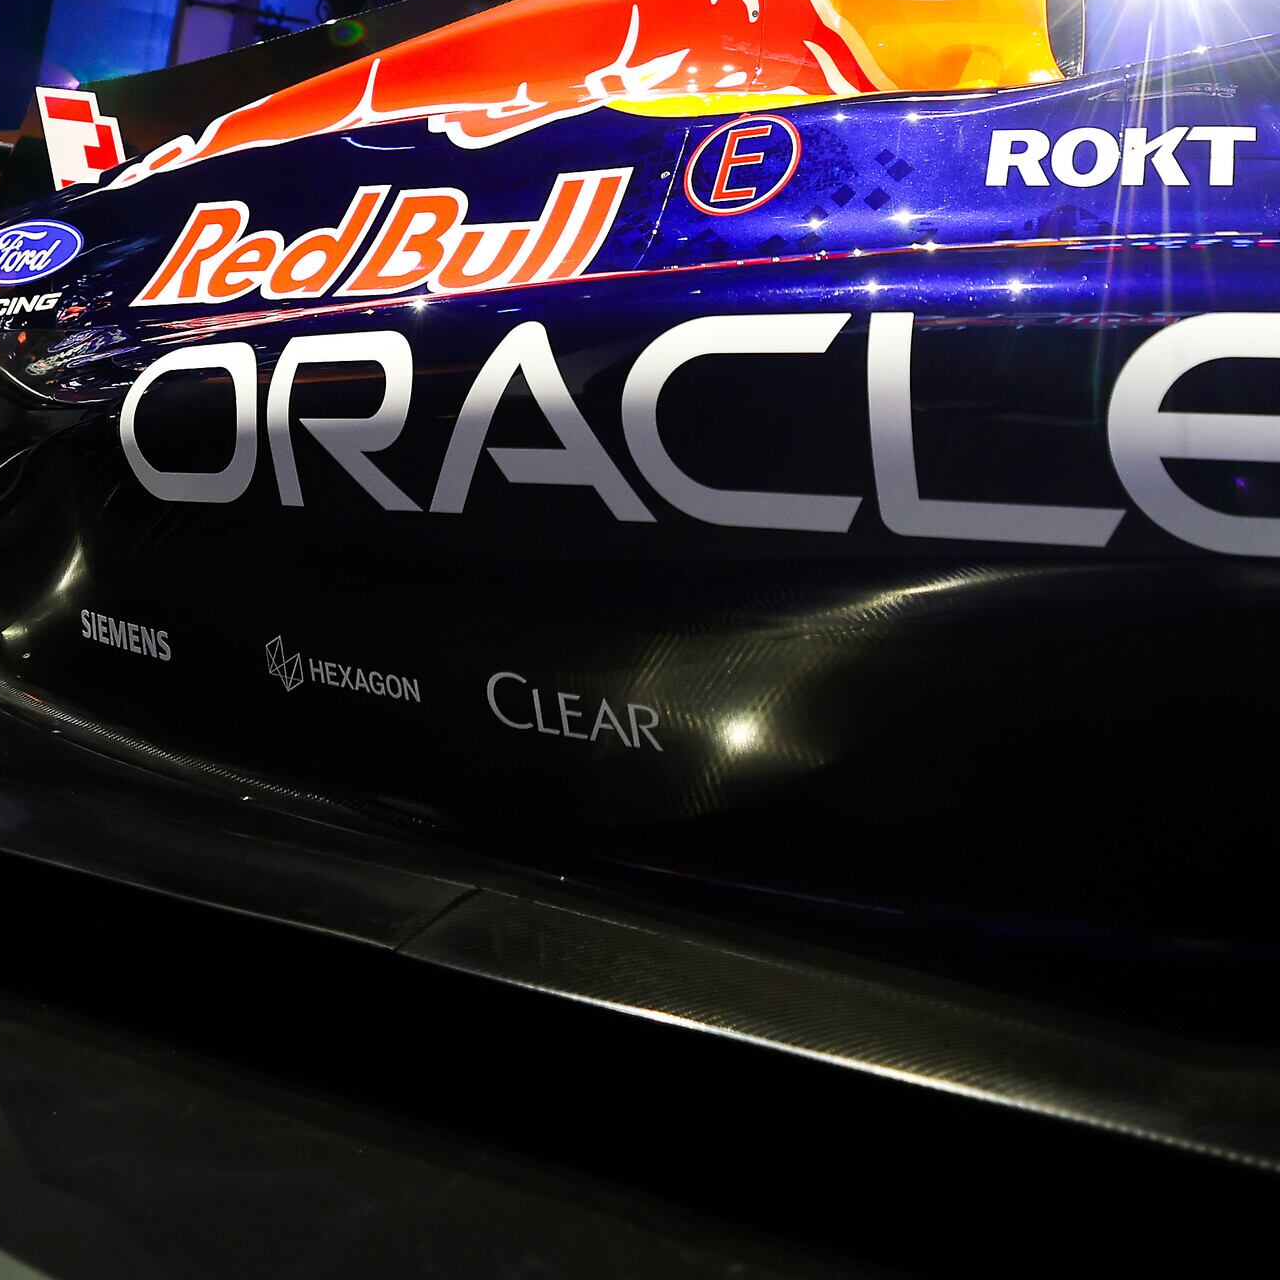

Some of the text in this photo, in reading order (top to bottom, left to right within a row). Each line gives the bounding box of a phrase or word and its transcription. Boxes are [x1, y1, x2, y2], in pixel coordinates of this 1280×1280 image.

[709, 124, 773, 203] E
[984, 125, 1258, 189] ROKT
[129, 166, 635, 307] Red Bull
[79, 608, 173, 663] SIEMENS
[308, 657, 422, 704] HEXAGON
[485, 670, 665, 753] CLEAR
